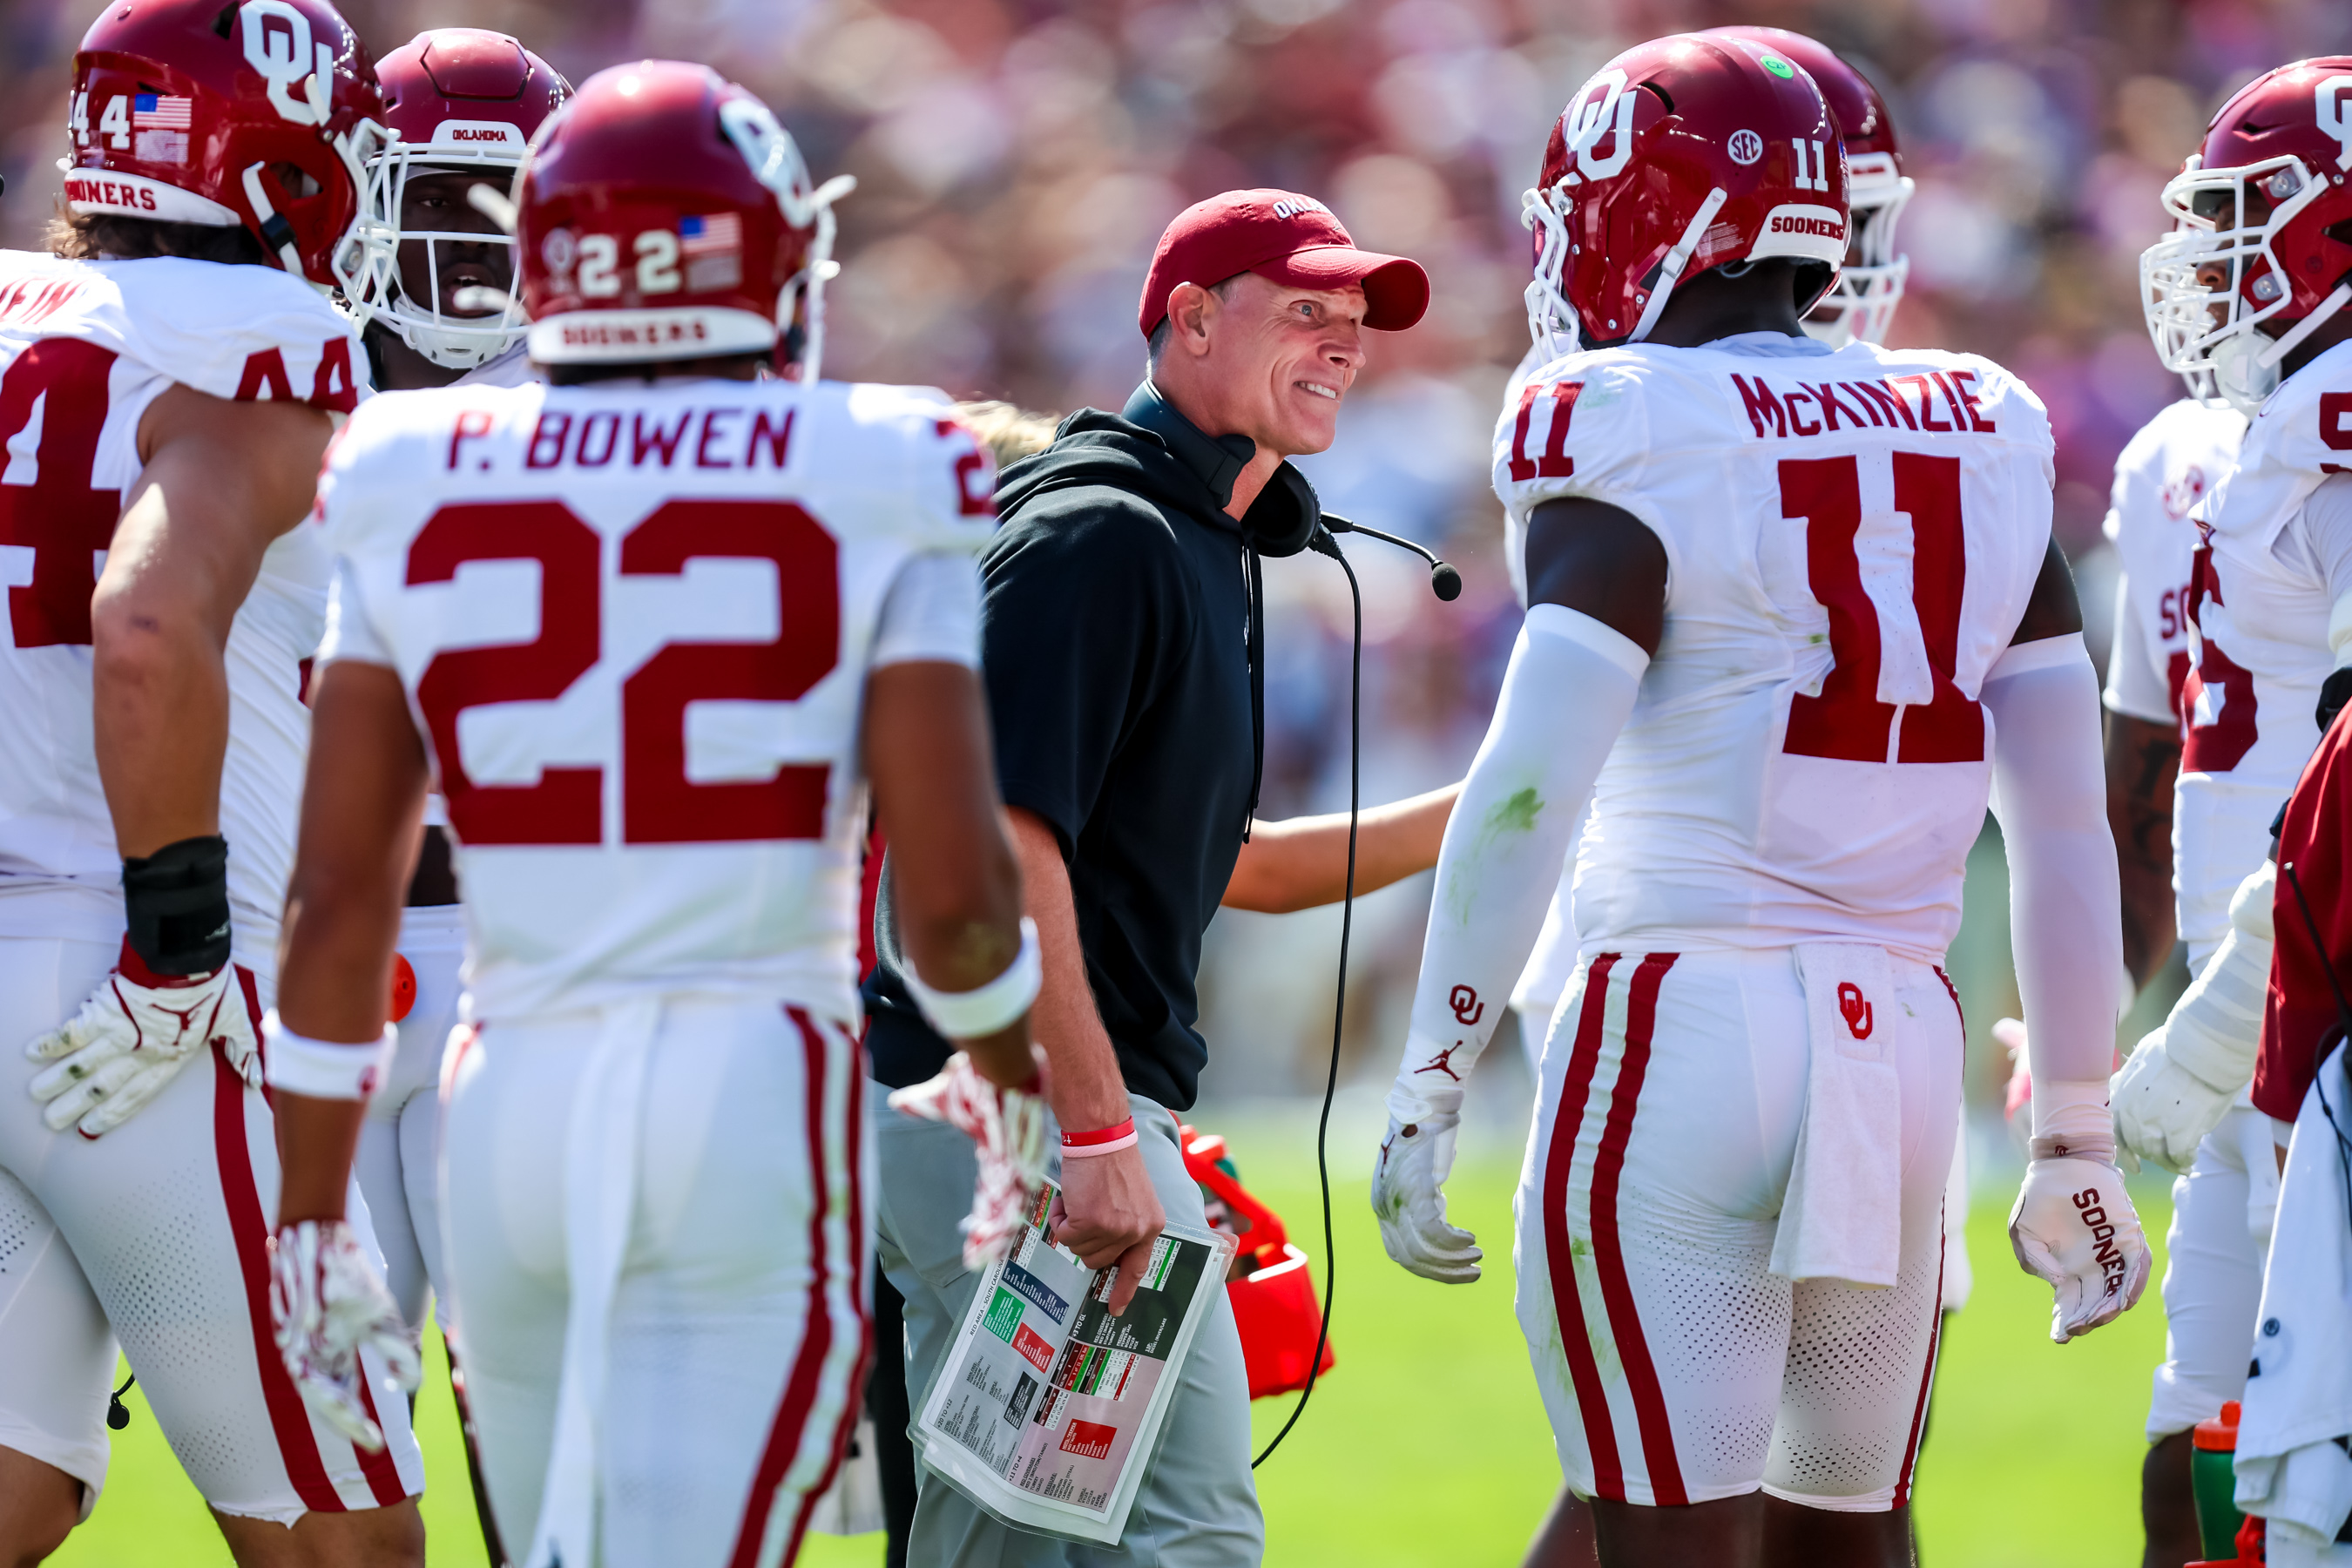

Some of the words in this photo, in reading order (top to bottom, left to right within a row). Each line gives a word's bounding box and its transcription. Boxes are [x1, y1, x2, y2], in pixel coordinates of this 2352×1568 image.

[240, 0, 334, 126] OU
[452, 129, 508, 142] OKLAHOMA
[1566, 68, 1637, 182] OU
[1731, 132, 1760, 161] SEC
[1792, 138, 1829, 193] 11
[1770, 216, 1845, 240] SOONERS
[578, 229, 681, 298] 22
[1508, 381, 1585, 482] 11
[1730, 369, 1997, 438] McKINZIE
[447, 409, 493, 470] P.
[525, 406, 797, 470] BOWEN
[1778, 450, 1985, 764] 11
[405, 497, 839, 846] 22
[1449, 983, 1484, 1025] OU
[1837, 981, 1873, 1040] OU
[969, 1324, 977, 1335] RED
[974, 1309, 984, 1324] AREA
[982, 1286, 994, 1304] SOUTH
[991, 1259, 1005, 1285] CAROLINA
[1075, 1321, 1082, 1330] TO
[1108, 1331, 1116, 1345] TURKEY
[1030, 1476, 1038, 1490] TURKEY
[1098, 1492, 1107, 1507] STROUD
